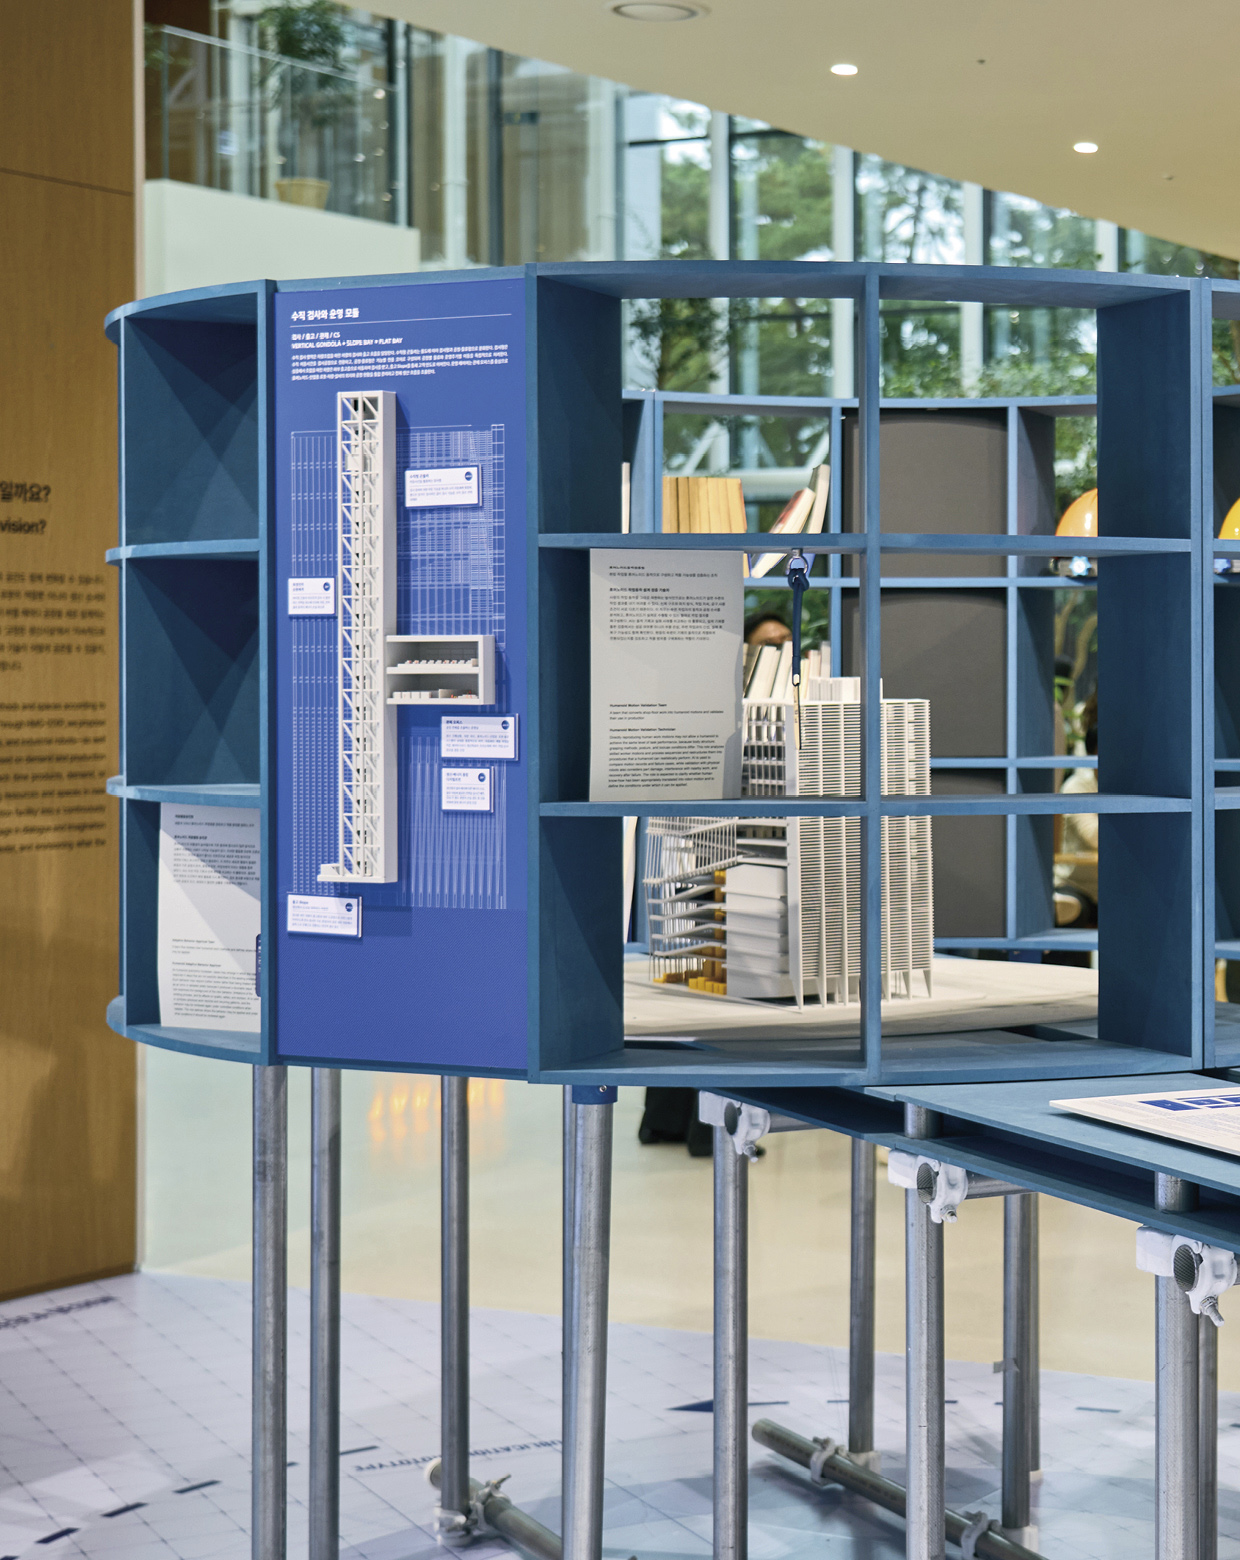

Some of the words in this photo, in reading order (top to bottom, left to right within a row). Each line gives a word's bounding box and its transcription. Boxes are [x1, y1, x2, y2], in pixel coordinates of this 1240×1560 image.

[291, 311, 306, 321] 수직
[307, 310, 328, 320] 검사와
[329, 309, 344, 320] 운영
[345, 308, 360, 318] 모듈
[0, 480, 51, 503] 일까요?
[0, 517, 46, 534] vision?
[469, 1440, 562, 1457] UBLICATIO
[354, 1454, 441, 1472] OTOTYPE
